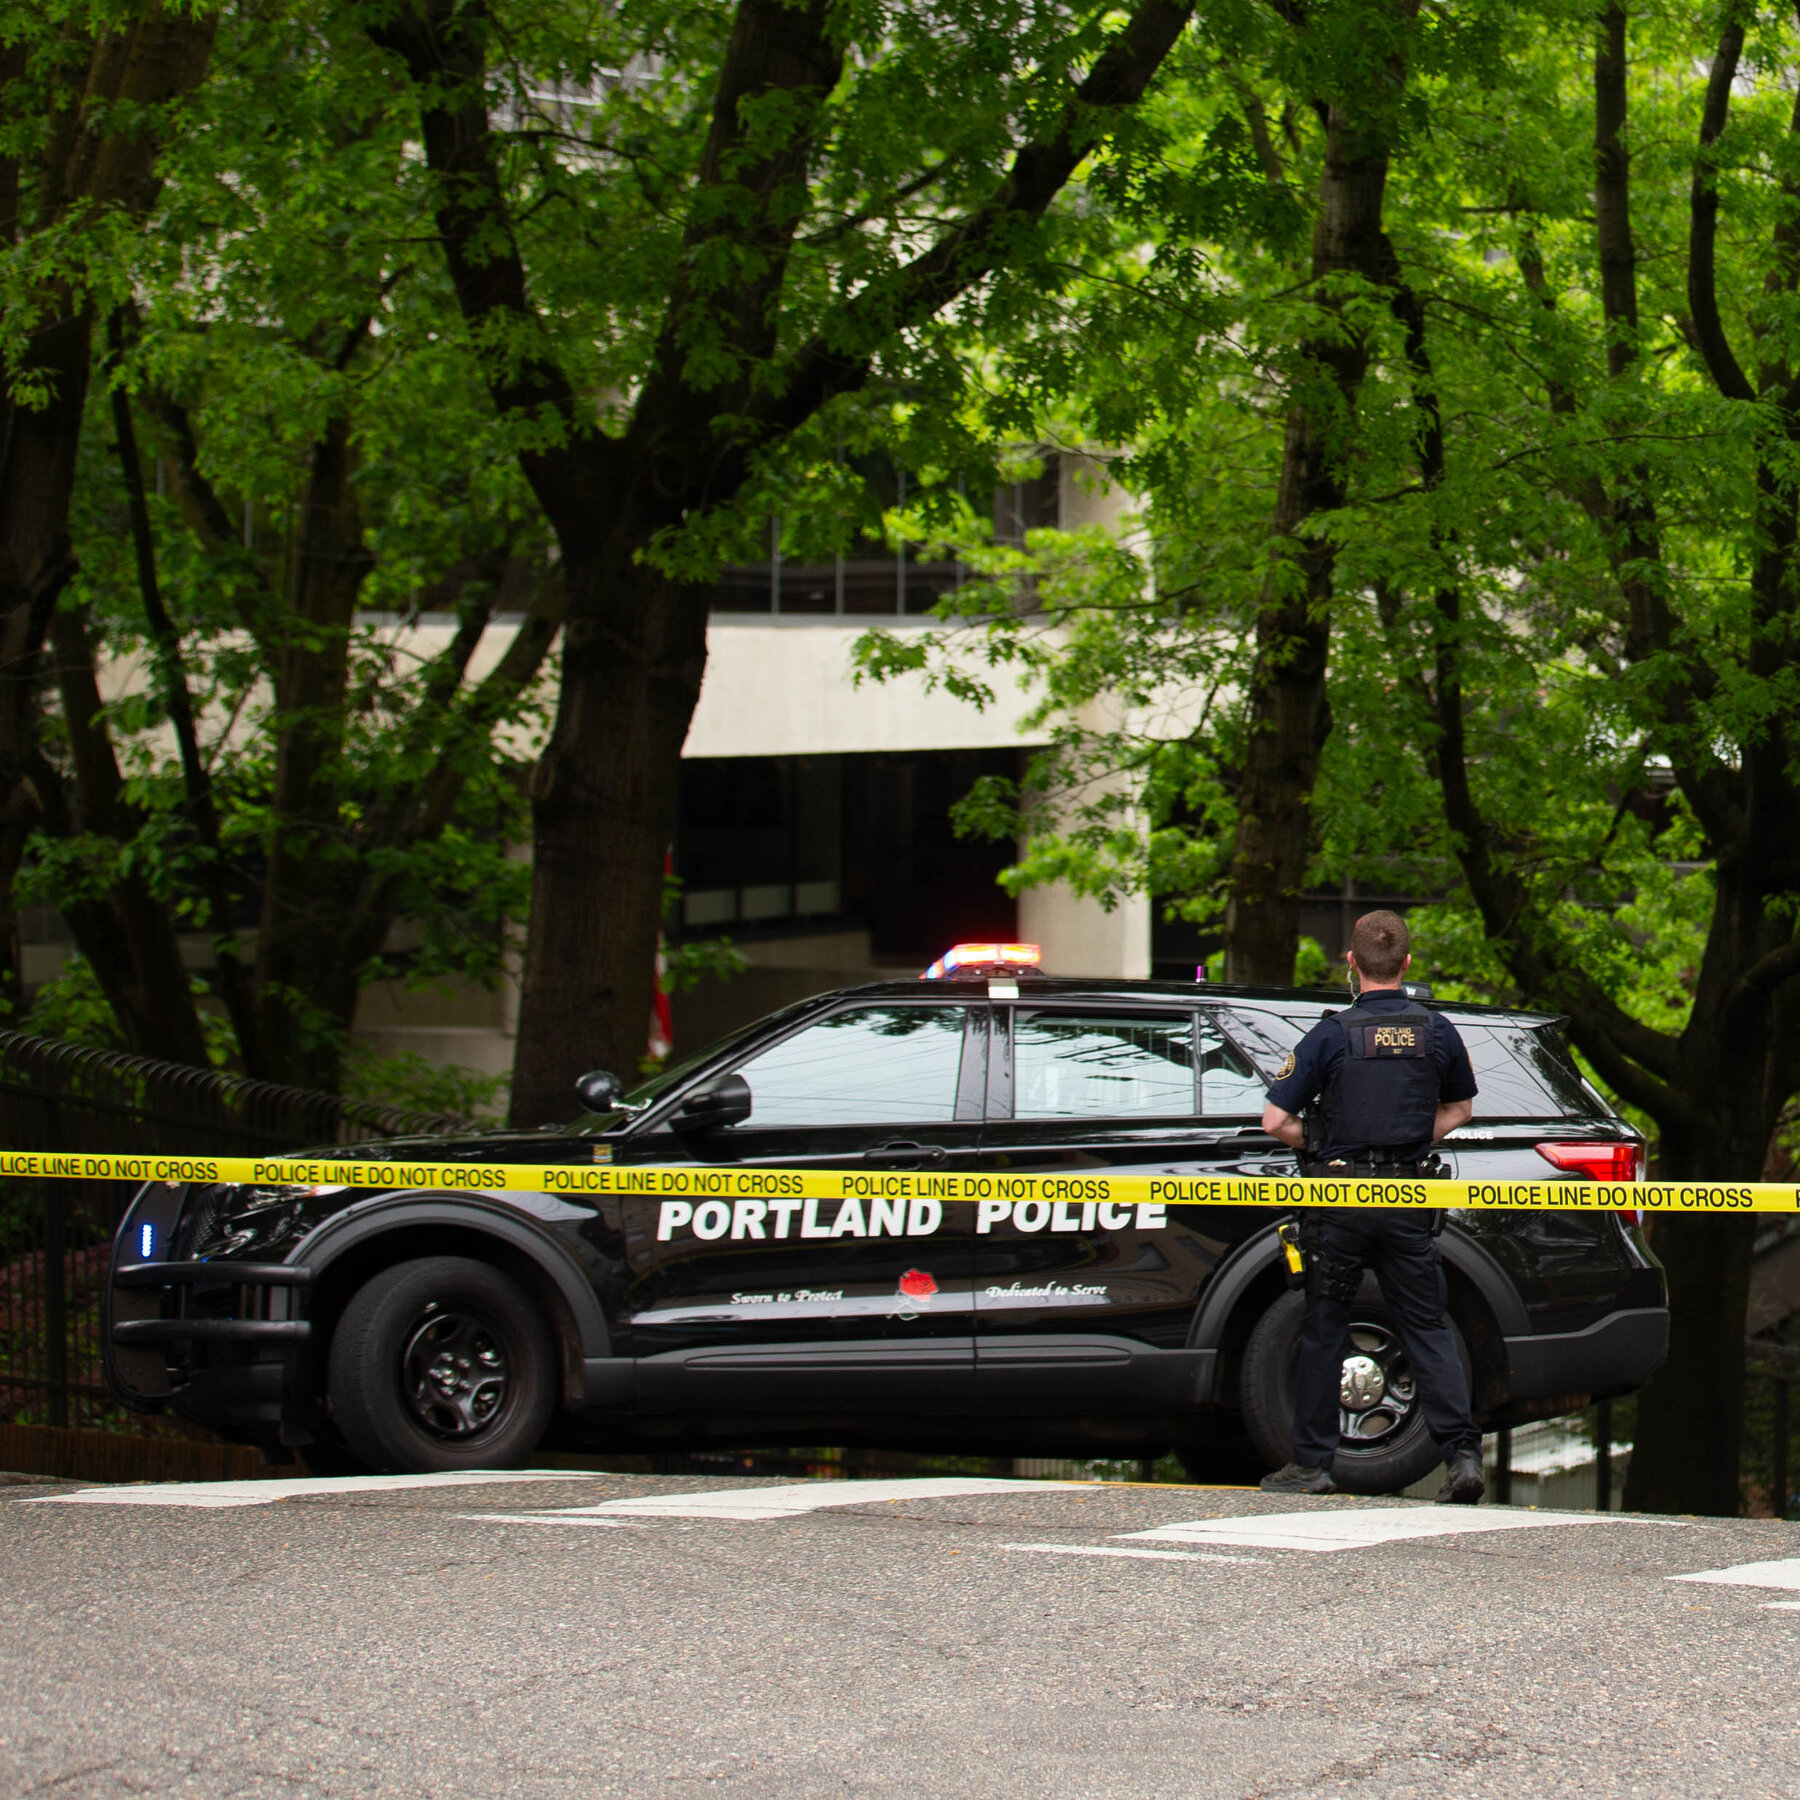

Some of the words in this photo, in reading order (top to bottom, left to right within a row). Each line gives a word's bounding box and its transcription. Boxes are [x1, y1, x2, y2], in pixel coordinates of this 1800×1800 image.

[1374, 1034, 1415, 1046] POLICE
[43, 1158, 81, 1174] LINE
[85, 1158, 110, 1175] DO
[115, 1160, 151, 1177] NOT
[155, 1160, 218, 1179] CROSS
[254, 1163, 319, 1182] POLICE
[325, 1166, 363, 1184] LINE
[368, 1166, 394, 1184] DO
[400, 1167, 436, 1185] NOT
[442, 1168, 505, 1187] CROSS
[544, 1170, 610, 1190] POLICE
[617, 1172, 656, 1190] LINE
[663, 1172, 688, 1191] DO
[695, 1173, 732, 1192] NOT
[738, 1174, 802, 1194] CROSS
[843, 1176, 911, 1195] POLICE
[918, 1178, 958, 1196] LINE
[965, 1178, 991, 1197] DO
[998, 1178, 1036, 1198] NOT
[1042, 1179, 1109, 1199] CROSS
[1151, 1181, 1221, 1200] POLICE
[1228, 1182, 1269, 1201] LINE
[1276, 1182, 1304, 1202] DO
[1311, 1183, 1350, 1202] NOT
[1356, 1183, 1426, 1204] CROSS
[1468, 1185, 1541, 1205] POLICE
[1548, 1186, 1591, 1205] LINE
[1598, 1186, 1626, 1206] DO
[1633, 1187, 1674, 1206] NOT
[1681, 1187, 1752, 1207] CROSS
[656, 1198, 943, 1241] PORTLAND
[976, 1200, 1168, 1234] POLICE
[731, 1293, 773, 1304] Sworn
[777, 1293, 791, 1303] to
[795, 1290, 843, 1302] Protect
[985, 1282, 1055, 1297] Dedicated
[1055, 1287, 1068, 1296] to
[1072, 1285, 1107, 1296] Serve
